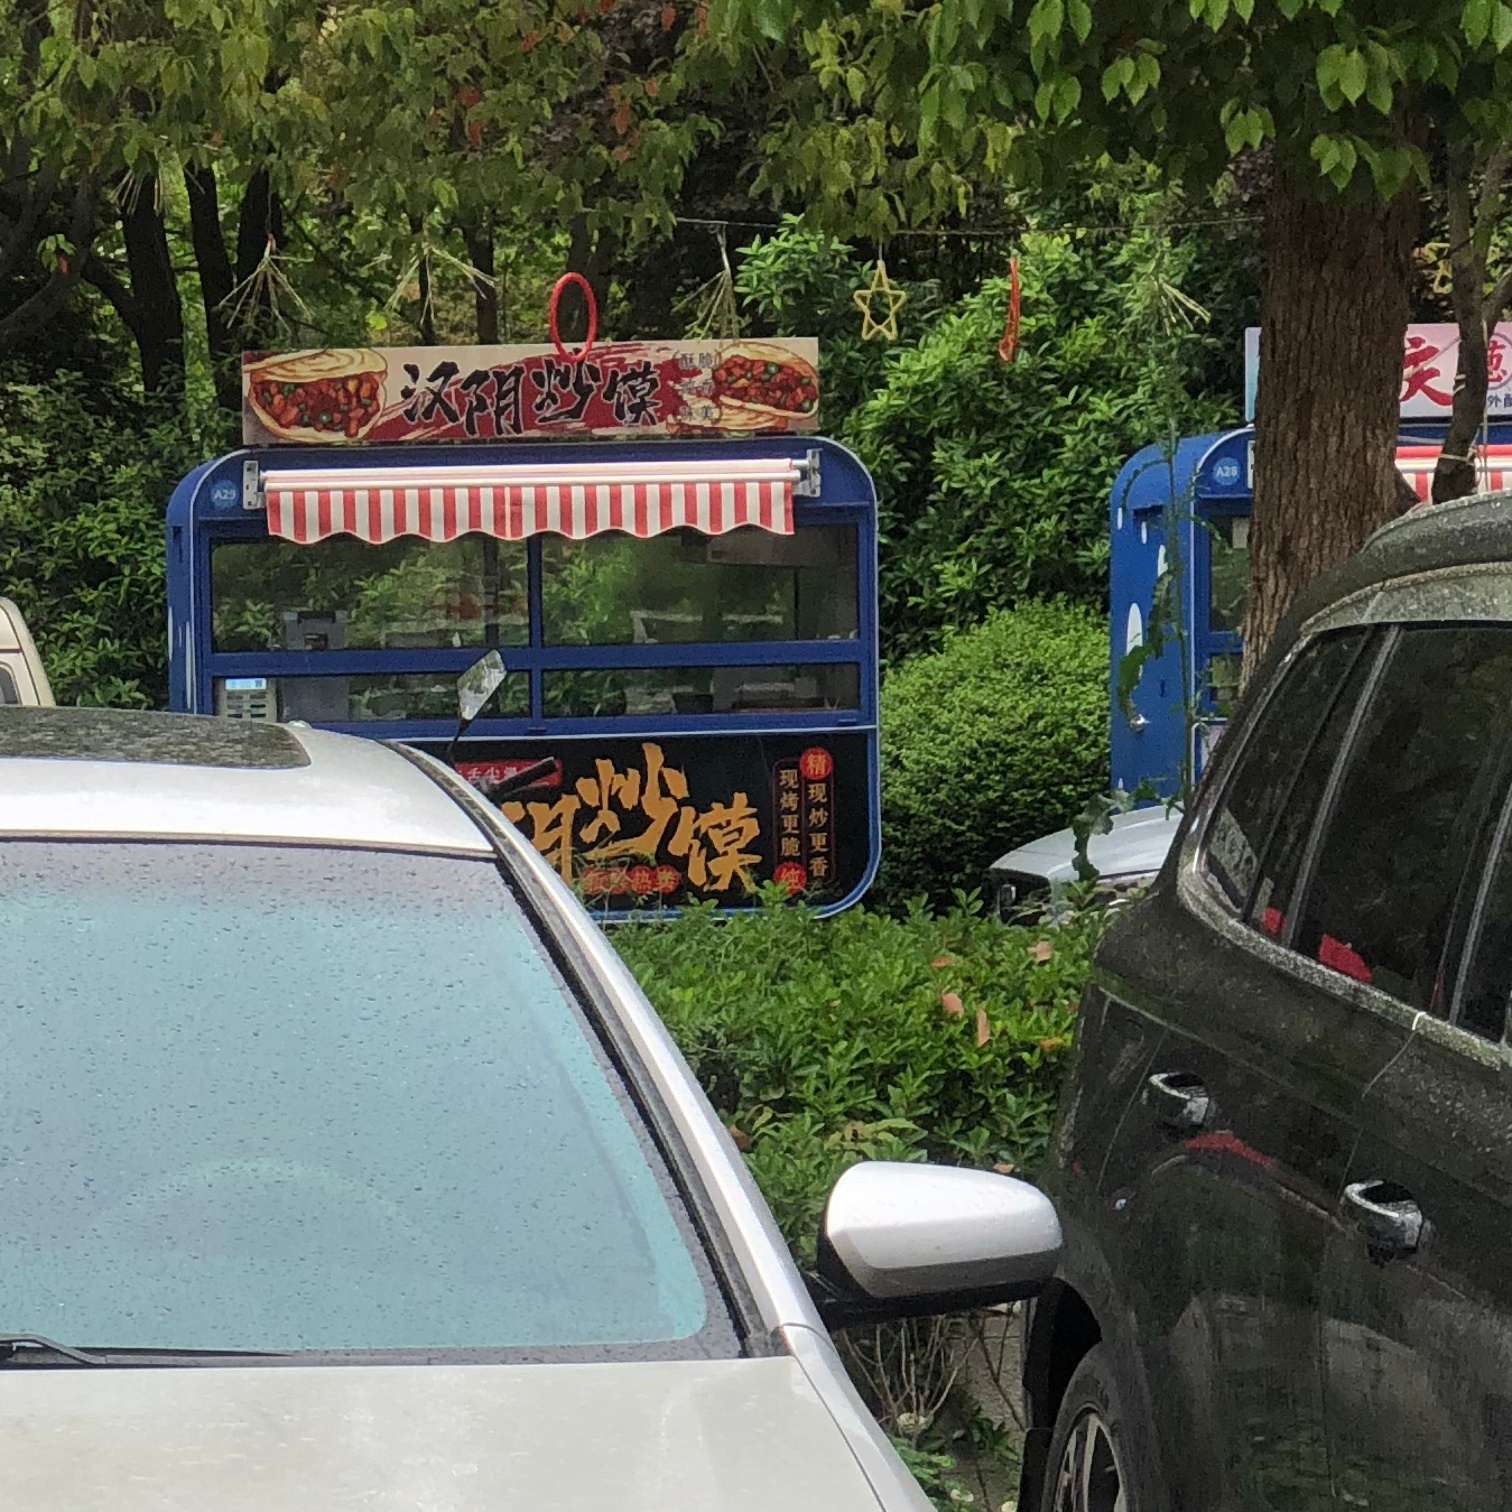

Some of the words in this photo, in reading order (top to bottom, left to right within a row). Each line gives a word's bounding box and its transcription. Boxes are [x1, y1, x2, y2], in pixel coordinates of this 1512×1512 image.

[401, 348, 663, 438] 汉阴炒馍
[779, 769, 801, 857] 现烤更脆
[808, 783, 829, 877] 现炒更香
